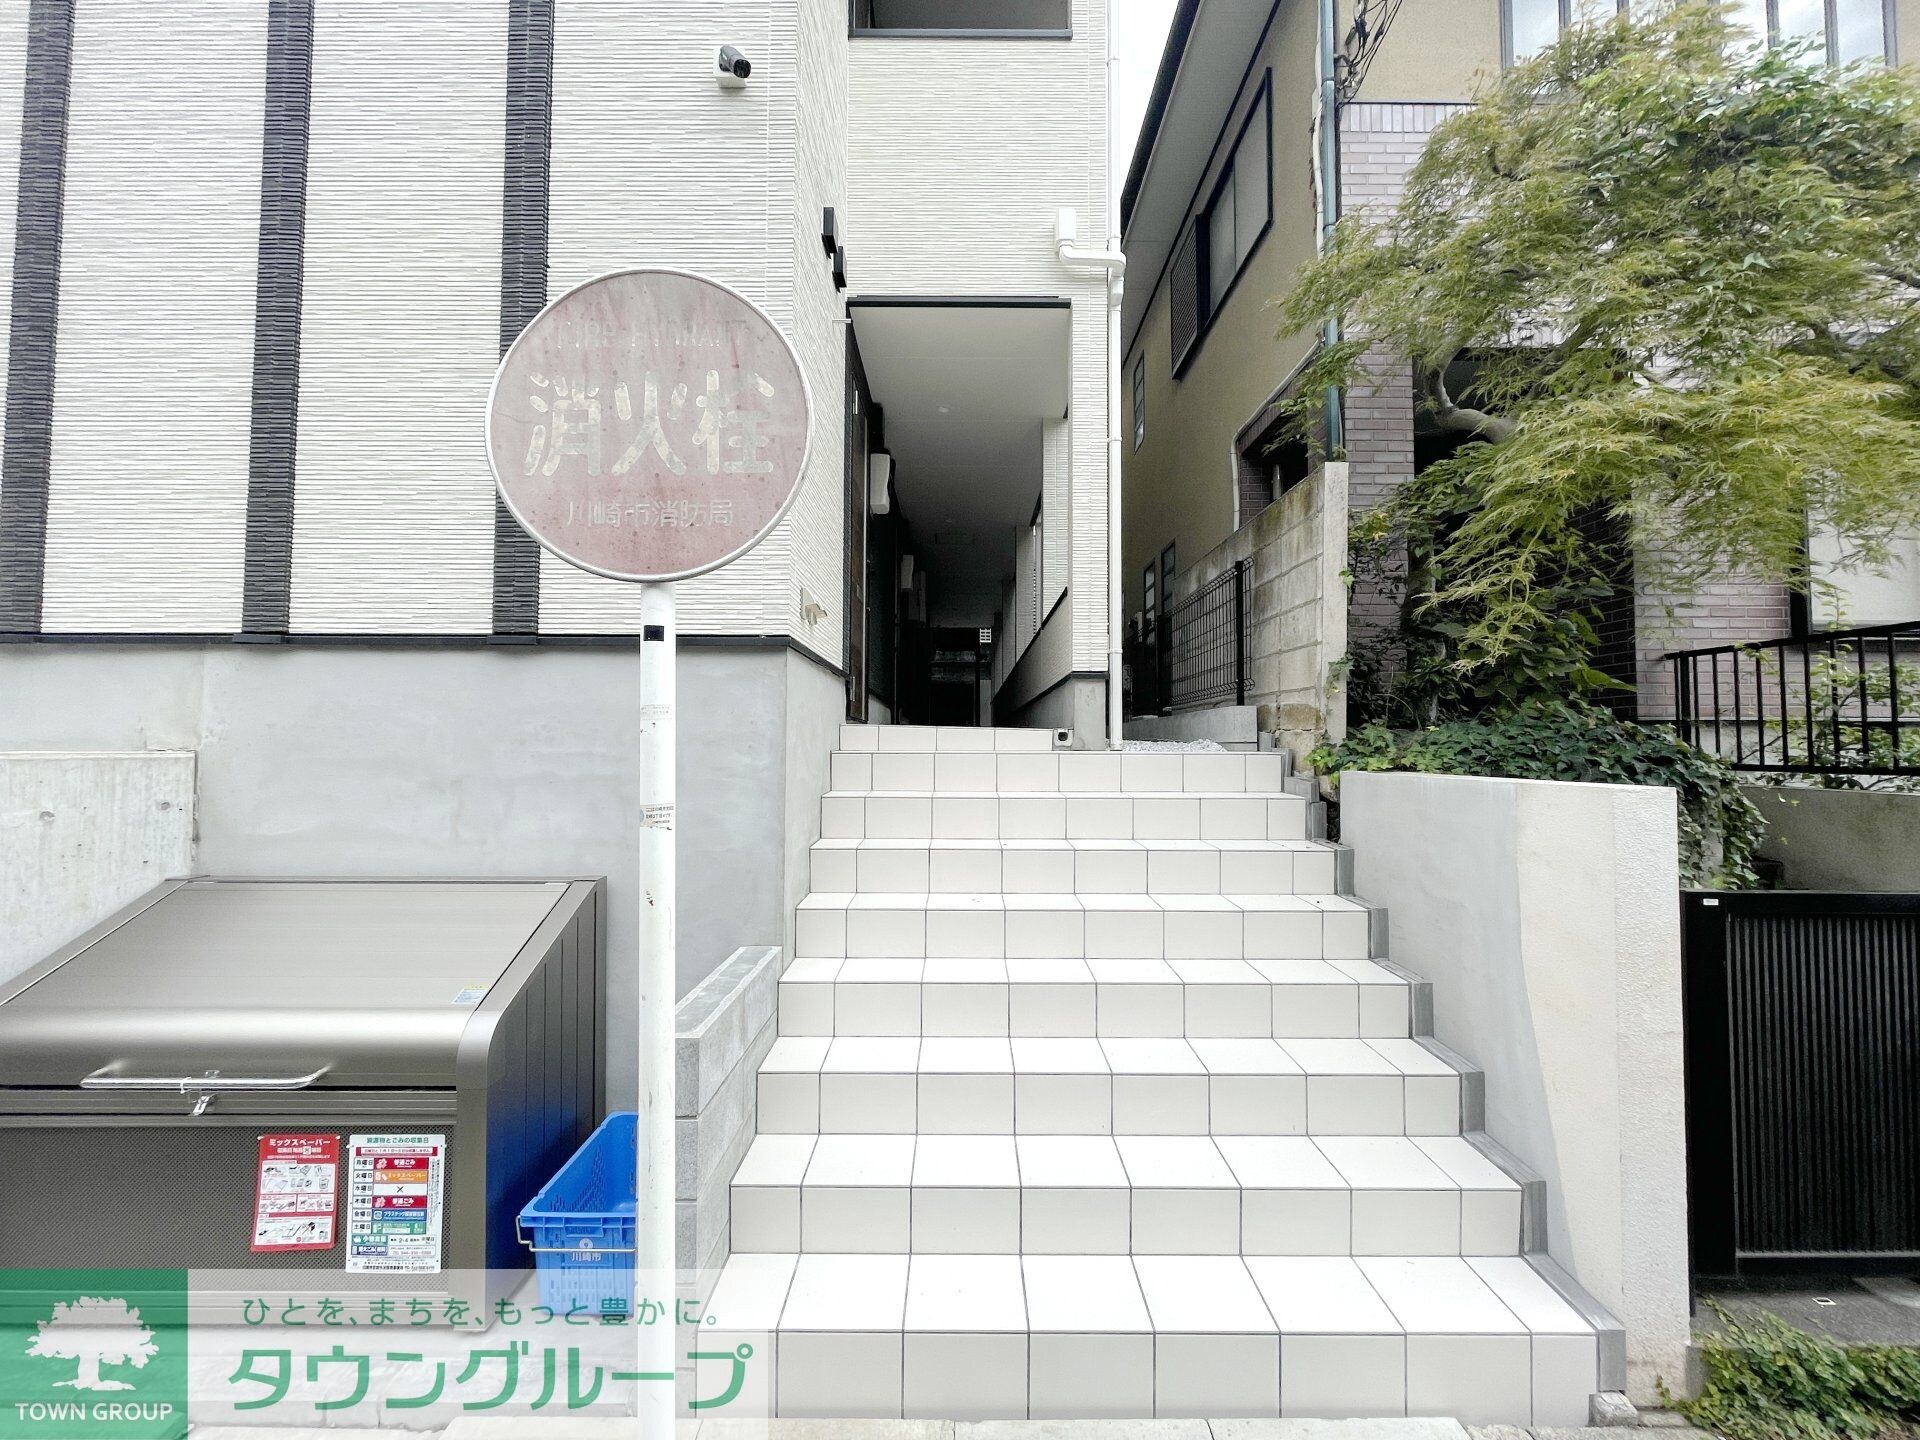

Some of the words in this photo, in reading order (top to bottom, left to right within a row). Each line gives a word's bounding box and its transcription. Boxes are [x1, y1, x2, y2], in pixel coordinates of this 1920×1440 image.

[269, 1138, 331, 1147] ミックスペーパー
